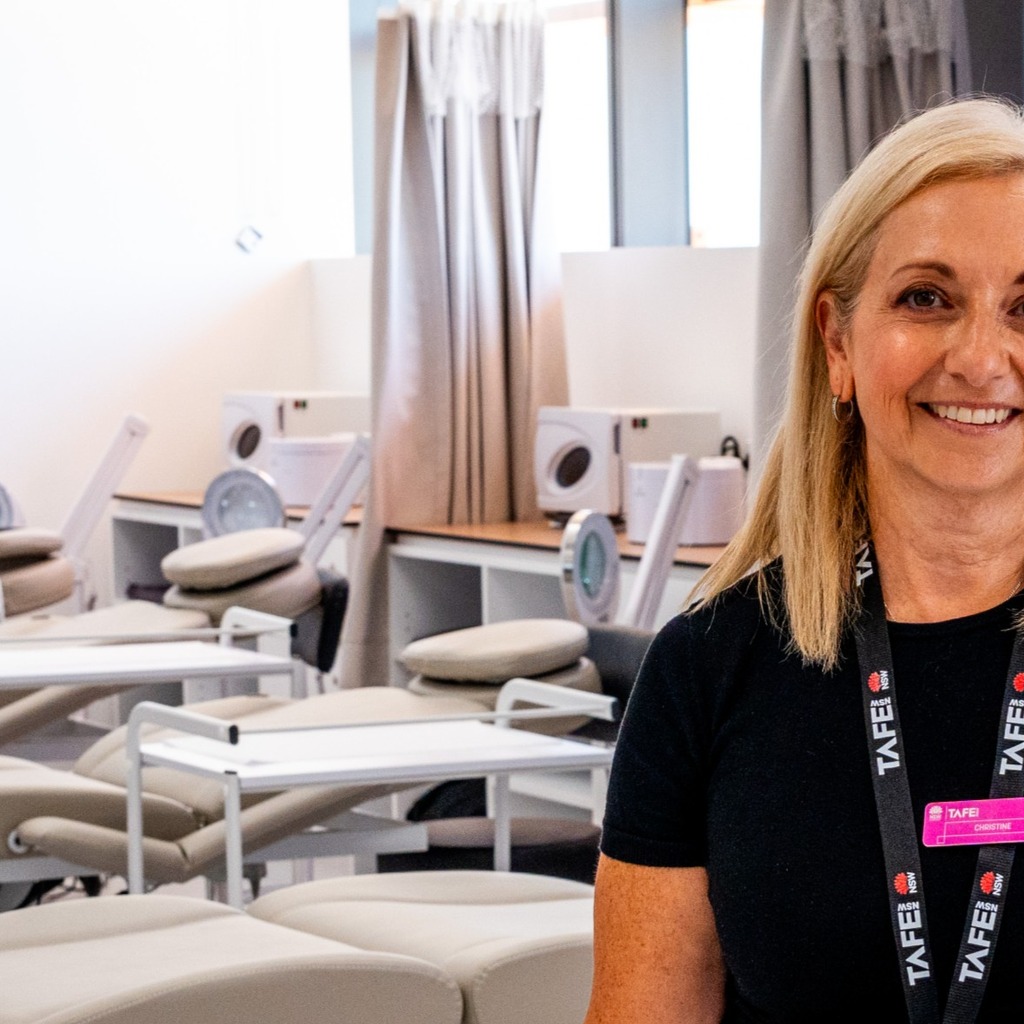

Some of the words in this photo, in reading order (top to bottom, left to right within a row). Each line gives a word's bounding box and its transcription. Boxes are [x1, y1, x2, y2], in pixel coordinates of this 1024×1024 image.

[855, 541, 873, 587] TA
[880, 670, 889, 690] NSW
[870, 697, 891, 707] NSW
[871, 705, 901, 775] TAFE
[948, 807, 976, 818] TAFE
[974, 822, 1012, 832] CHRISTINE
[907, 872, 917, 894] NSW
[993, 873, 1004, 896] NSW
[897, 901, 920, 911] NSW
[975, 900, 999, 912] NSW
[898, 909, 930, 986] TAFE
[959, 909, 997, 982] TAFE
